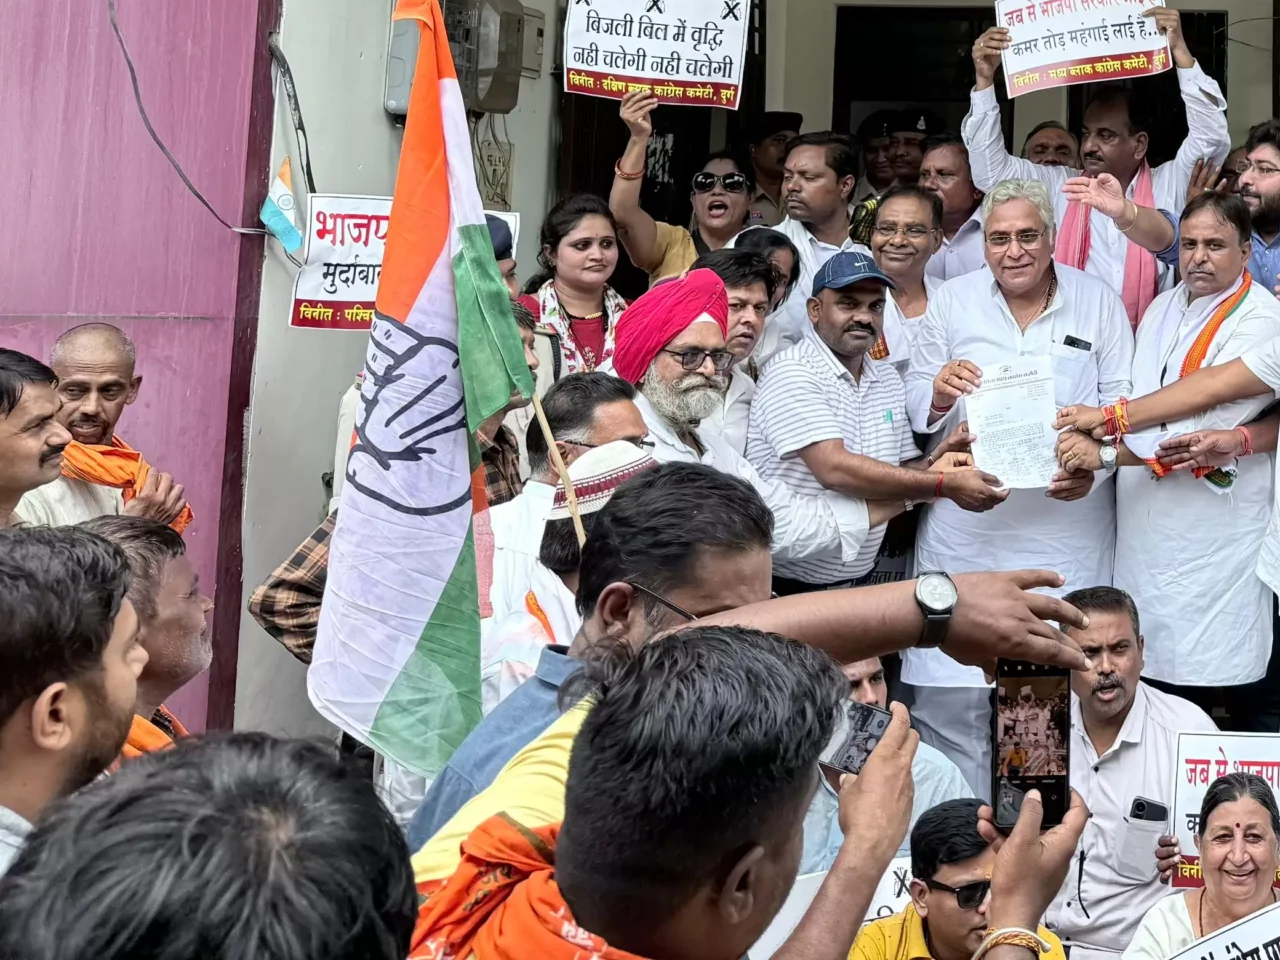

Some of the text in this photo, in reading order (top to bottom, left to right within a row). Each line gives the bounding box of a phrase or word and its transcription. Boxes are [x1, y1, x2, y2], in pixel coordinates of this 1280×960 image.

[586, 9, 724, 52] बिजली बिल में वृद्धि
[1004, 8, 1023, 28] जब
[1011, 37, 1040, 57] कमर
[1041, 28, 1066, 51] तोड़
[1067, 18, 1110, 47] महंगाई
[1111, 15, 1136, 41] लाई
[573, 42, 734, 79] नही चलेगी नही चलेगी
[1069, 64, 1093, 76] ब्लाक
[1094, 57, 1122, 74] कांग्रेस
[569, 71, 594, 88] विनीत
[602, 76, 626, 93] दक्षिण
[654, 81, 683, 99] कांग्रेस
[720, 87, 734, 104] दुर्ग
[316, 210, 390, 248] भाजप
[322, 254, 382, 294] मुर्दाबा
[300, 302, 333, 321] विनीत
[344, 304, 375, 322] पश्चि
[1185, 758, 1211, 787] जब
[1177, 858, 1203, 879] विनी
